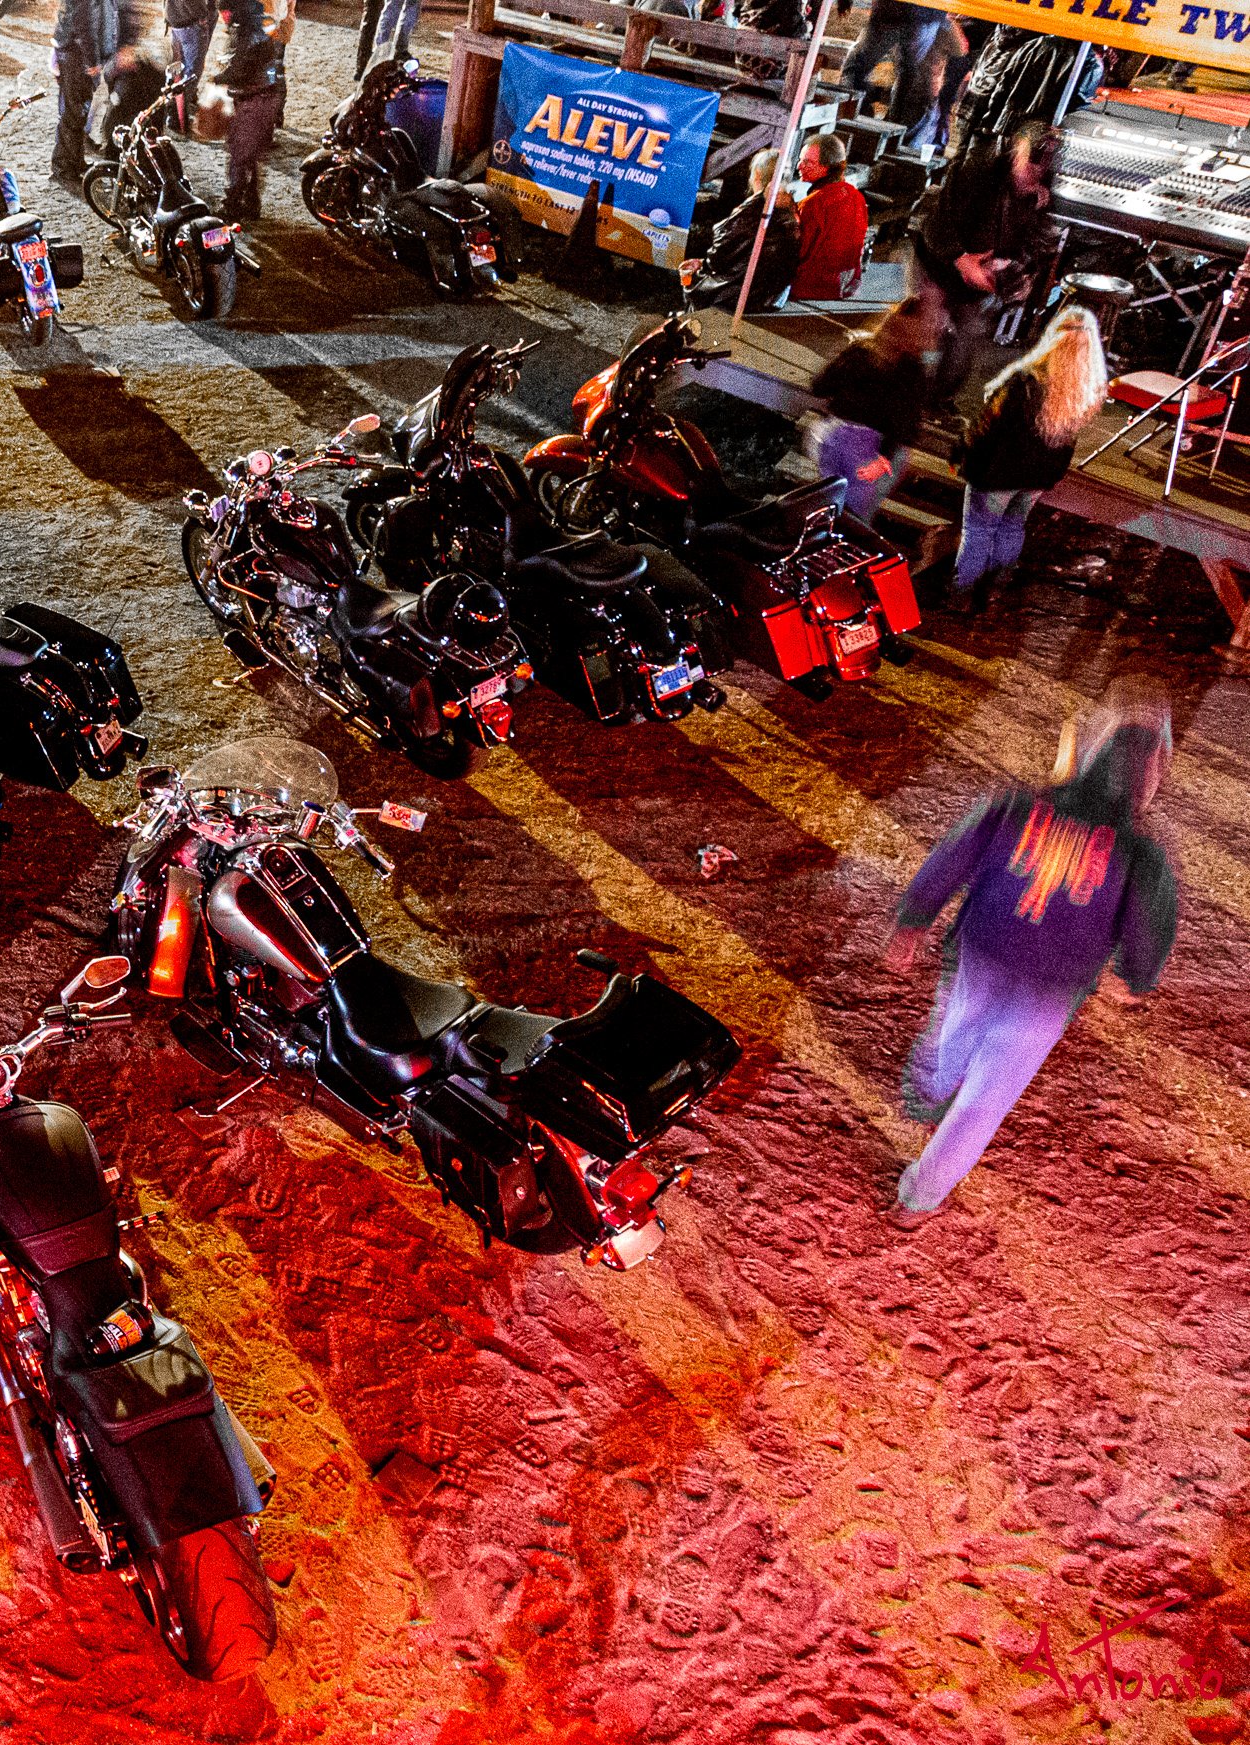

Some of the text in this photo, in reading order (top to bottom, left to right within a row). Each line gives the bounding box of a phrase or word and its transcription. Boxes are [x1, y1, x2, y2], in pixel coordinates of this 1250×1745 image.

[577, 97, 590, 108] ALL
[591, 101, 608, 112] DAY
[523, 94, 671, 169] ALEVE
[550, 147, 574, 163] sodium
[573, 153, 596, 172] tablets,
[597, 159, 614, 175] 220
[612, 167, 625, 180] mg
[624, 167, 659, 189] (NSAID)
